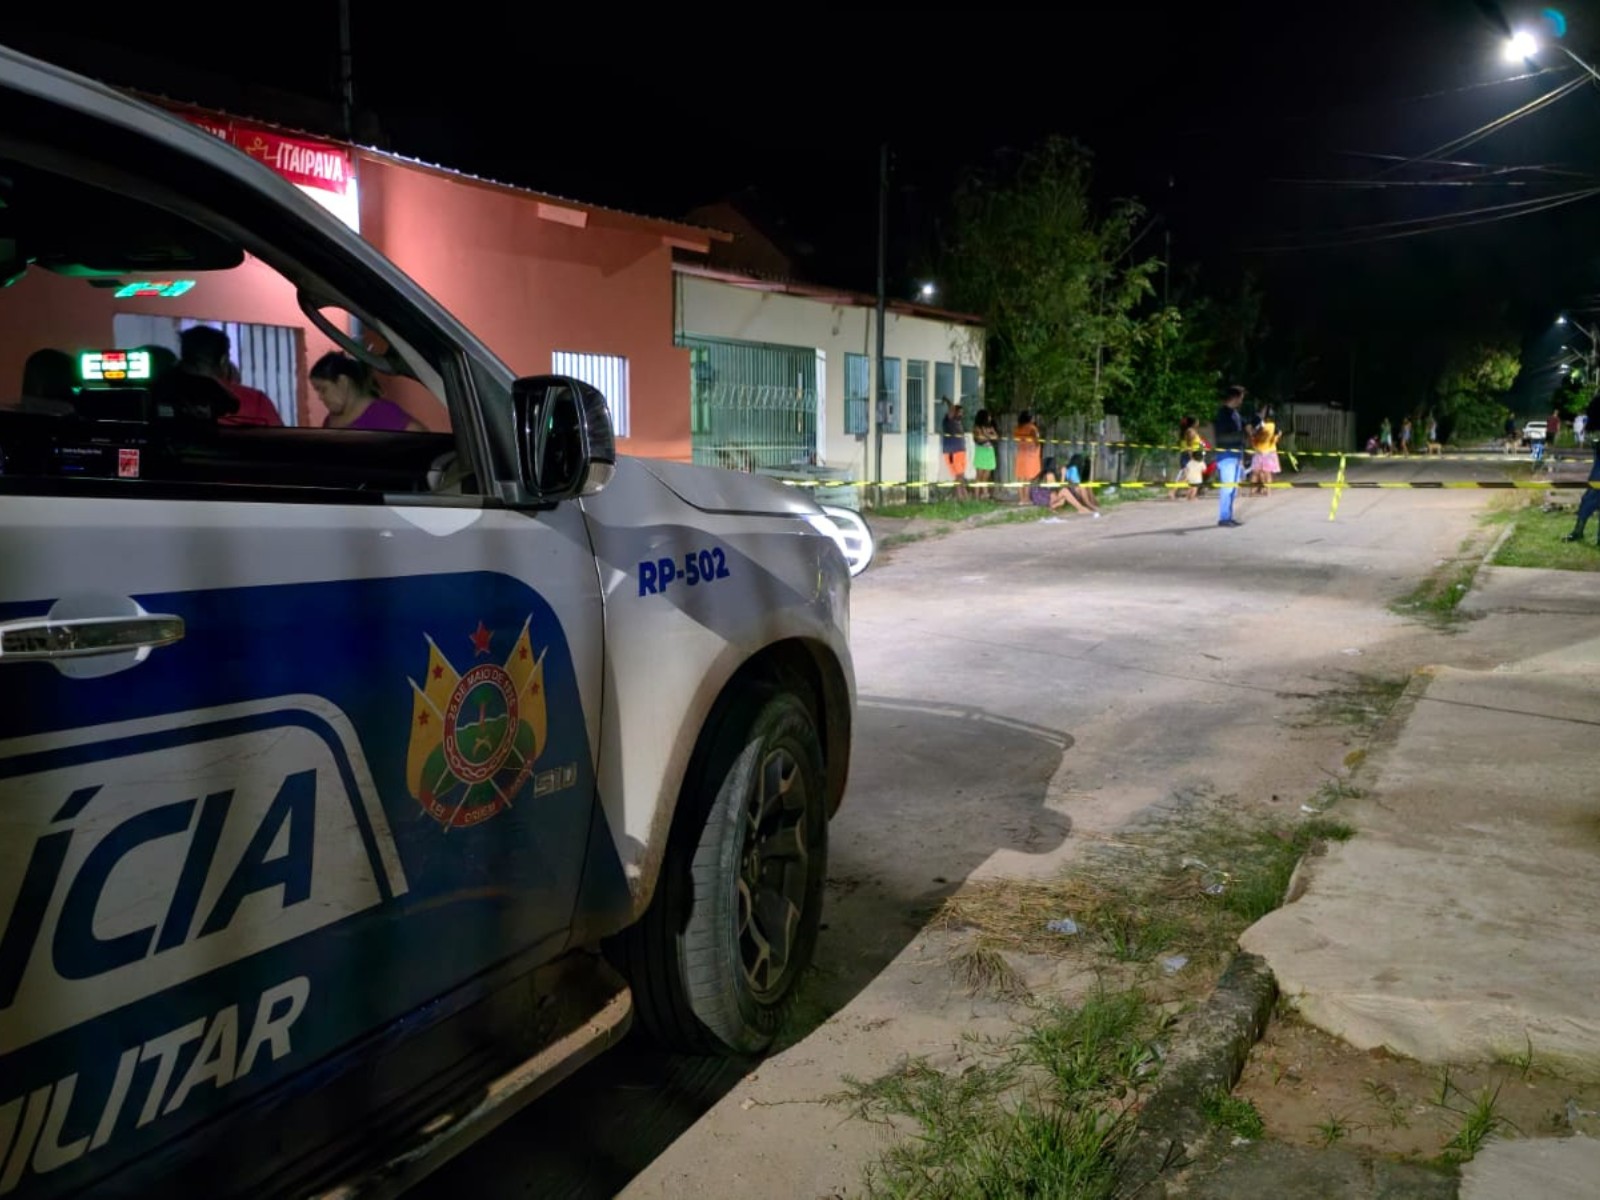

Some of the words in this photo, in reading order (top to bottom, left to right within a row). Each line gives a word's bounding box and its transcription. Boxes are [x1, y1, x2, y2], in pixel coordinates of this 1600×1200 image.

[276, 142, 344, 182] ITAIPAVA
[638, 547, 730, 597] RP-502
[466, 669, 491, 686] MAIO
